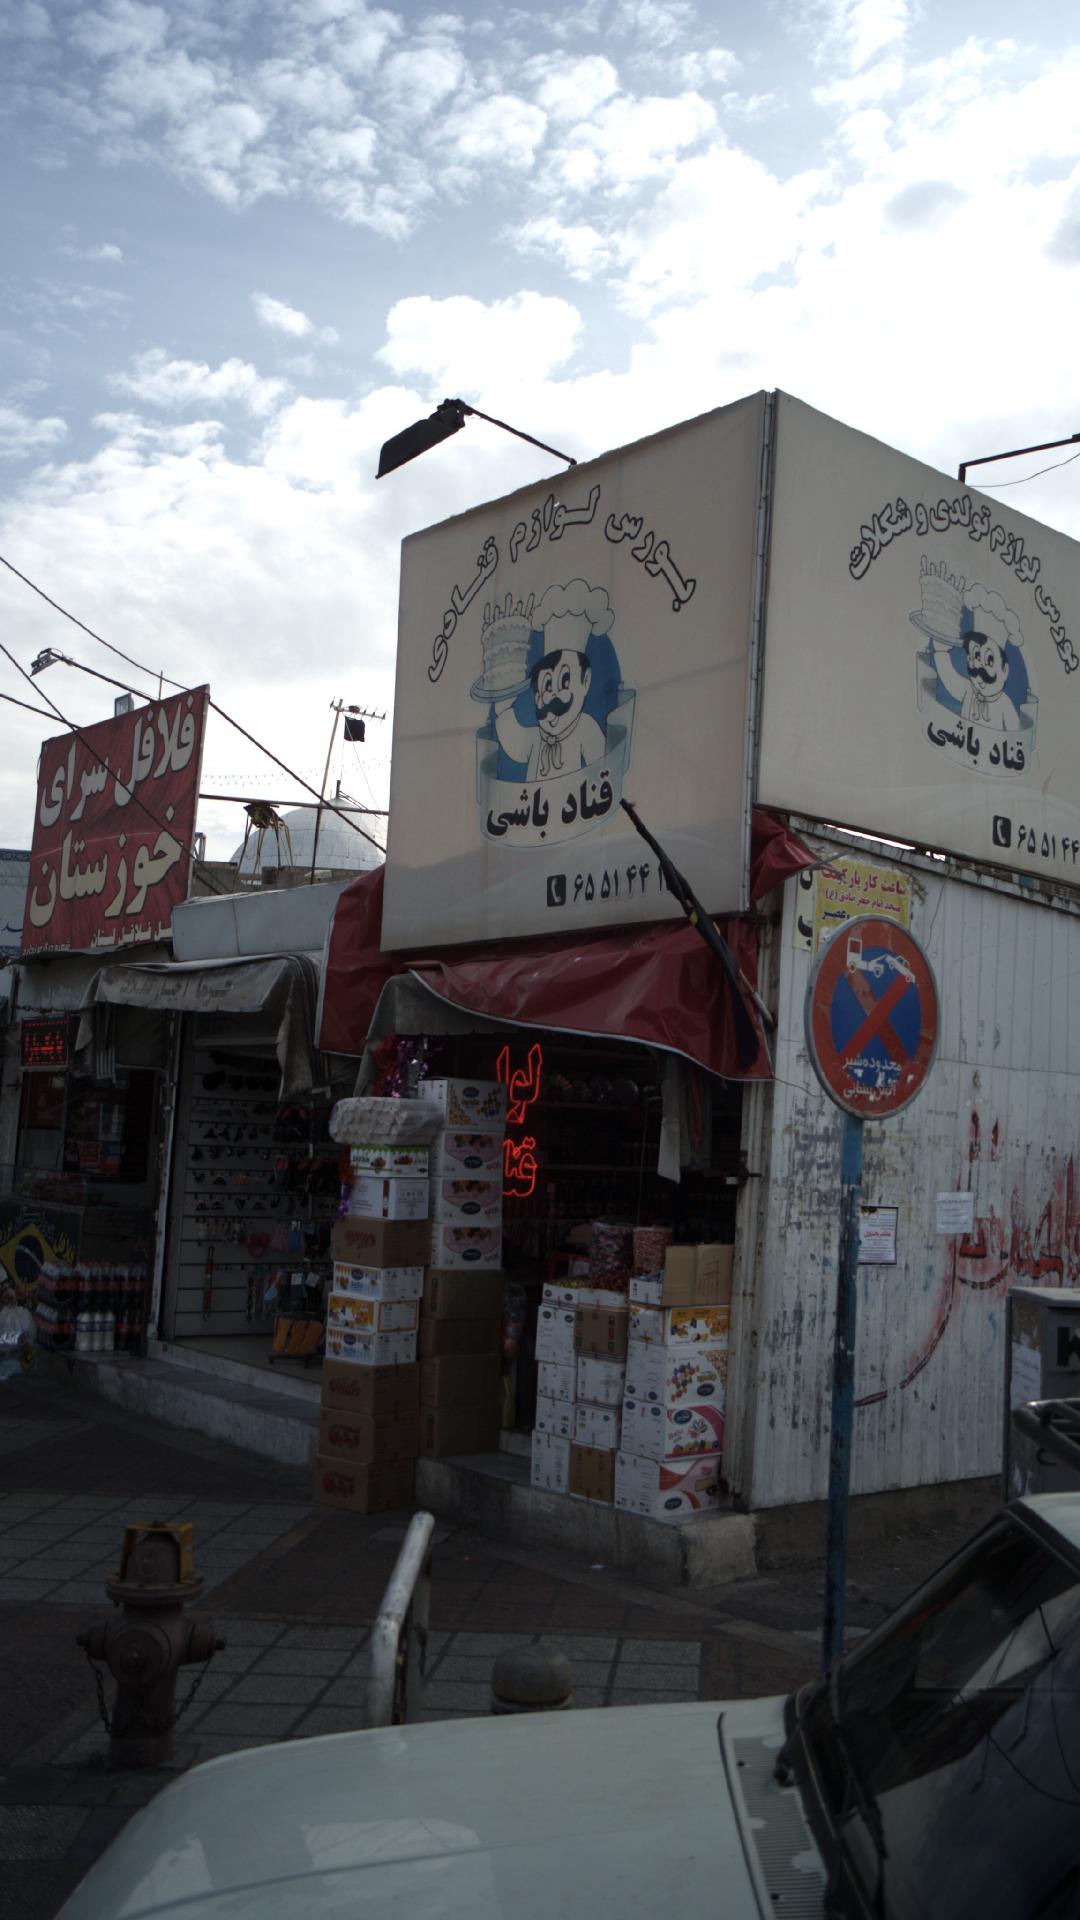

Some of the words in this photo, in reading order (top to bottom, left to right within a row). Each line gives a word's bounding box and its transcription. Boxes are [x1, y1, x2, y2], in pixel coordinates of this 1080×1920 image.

[509, 484, 601, 563] لوازم
[849, 497, 913, 580] شکلات
[915, 503, 929, 536] و
[989, 526, 1041, 584] لوازم
[604, 512, 697, 612] بورس
[427, 536, 499, 683] قنادی
[1034, 585, 1079, 674] بورس
[114, 695, 195, 807] فلافل
[927, 719, 980, 764] باشی
[989, 741, 1025, 771] قناد
[39, 739, 110, 828] سرای
[486, 787, 550, 838] باشی
[560, 771, 614, 825] قناد
[28, 804, 185, 929] خوزستان
